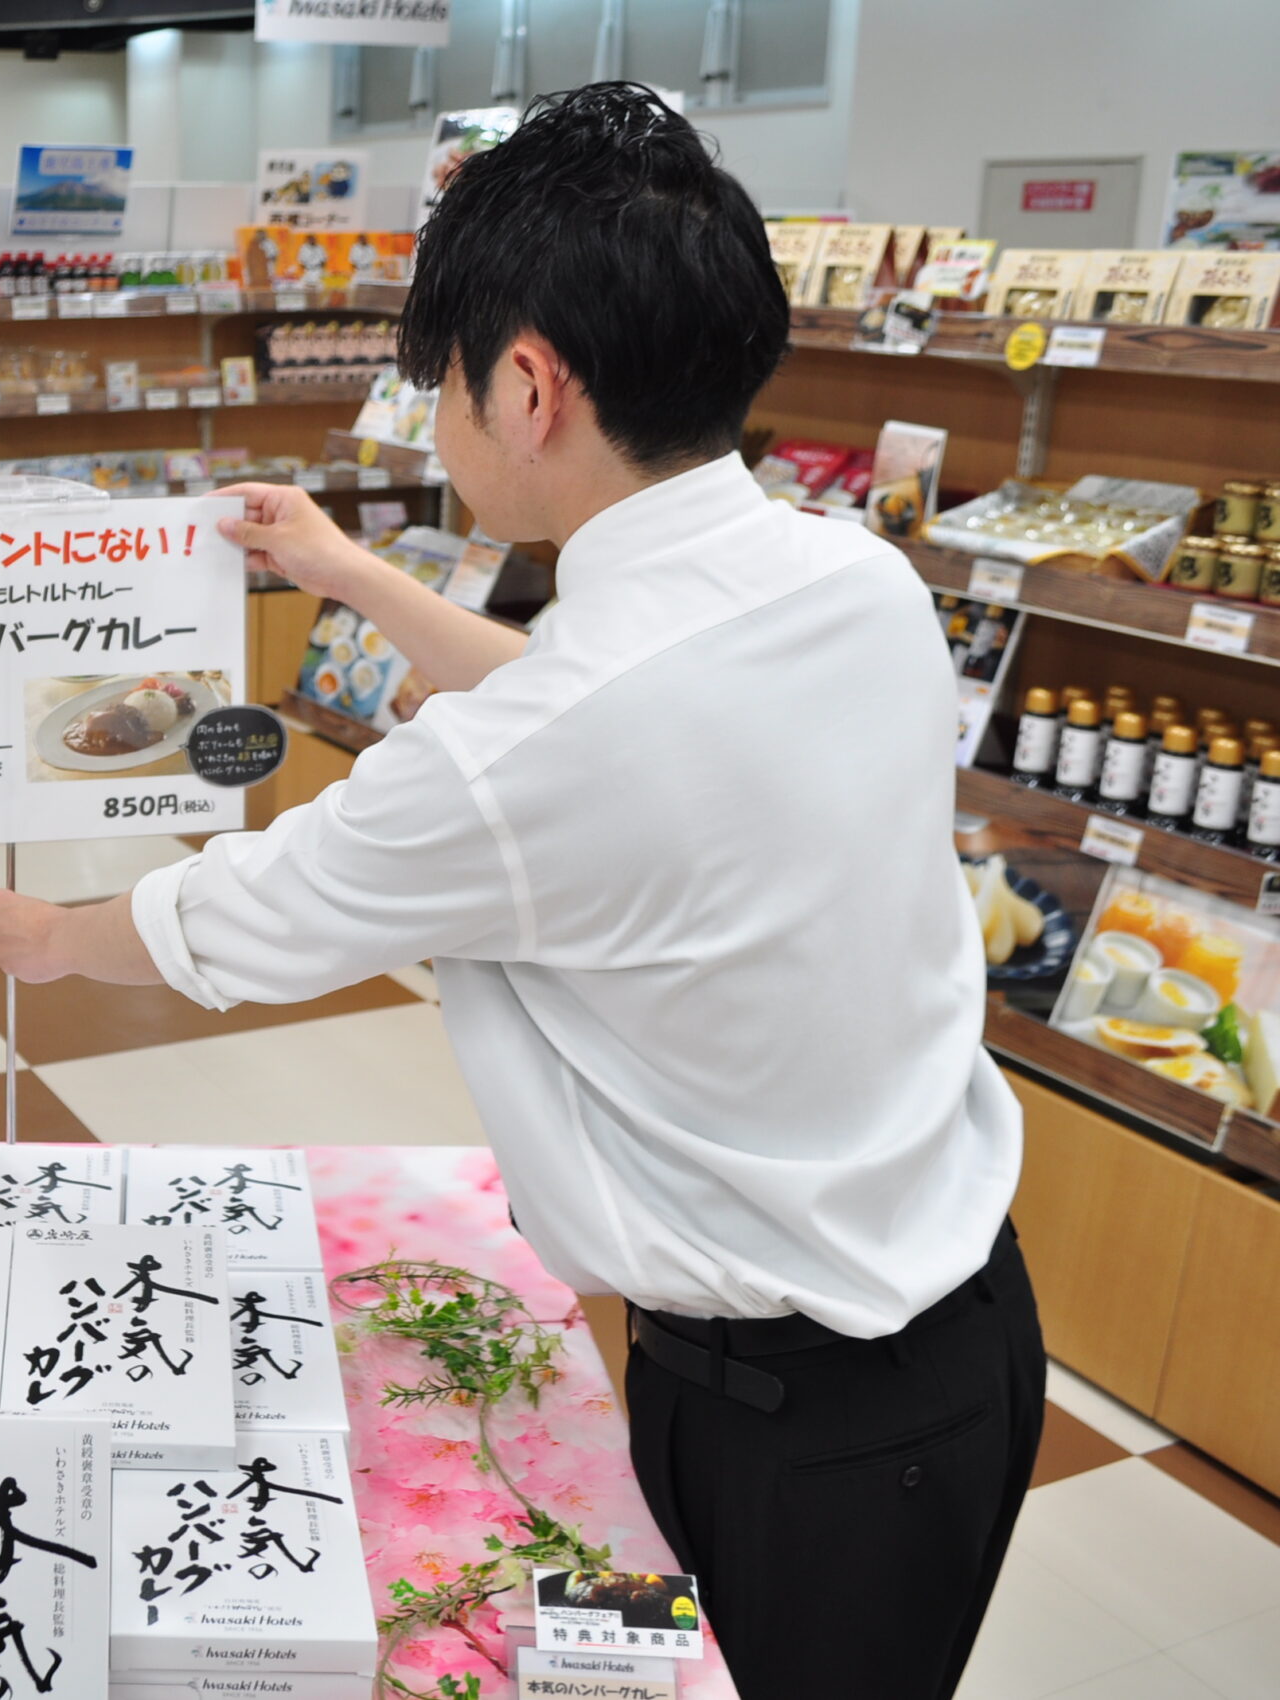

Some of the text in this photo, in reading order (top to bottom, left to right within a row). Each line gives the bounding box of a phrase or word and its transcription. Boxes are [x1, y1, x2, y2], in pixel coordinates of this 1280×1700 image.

[24, 1162, 112, 1224] 本気
[168, 1176, 216, 1227] ハンバー
[213, 1163, 302, 1235] 本気の
[56, 1277, 113, 1401] ハンバーグ
[112, 1254, 220, 1383] 本気の
[230, 1291, 324, 1386] 本気の
[22, 1345, 61, 1411] カレ
[129, 1449, 165, 1461] Hotels
[131, 1419, 171, 1432] Hotels
[54, 1446, 66, 1538] いわさきホテルズ
[80, 1433, 94, 1521] 黄綬褒章受章の
[166, 1480, 232, 1597] ハンバーグ
[226, 1457, 344, 1580] 本気の
[52, 1562, 66, 1638] 総料理長監修
[132, 1545, 173, 1626] カレー
[201, 1613, 303, 1627] Iwasaki Hotels
[206, 1646, 297, 1660] Iwasaki Hotels
[553, 1627, 690, 1648] 特典対象商品
[202, 1678, 293, 1693] Iwasaki Hotels
[527, 1680, 668, 1700] 本気のハンバーグカレー
[561, 1658, 635, 1673] Iwasaki Hotels
